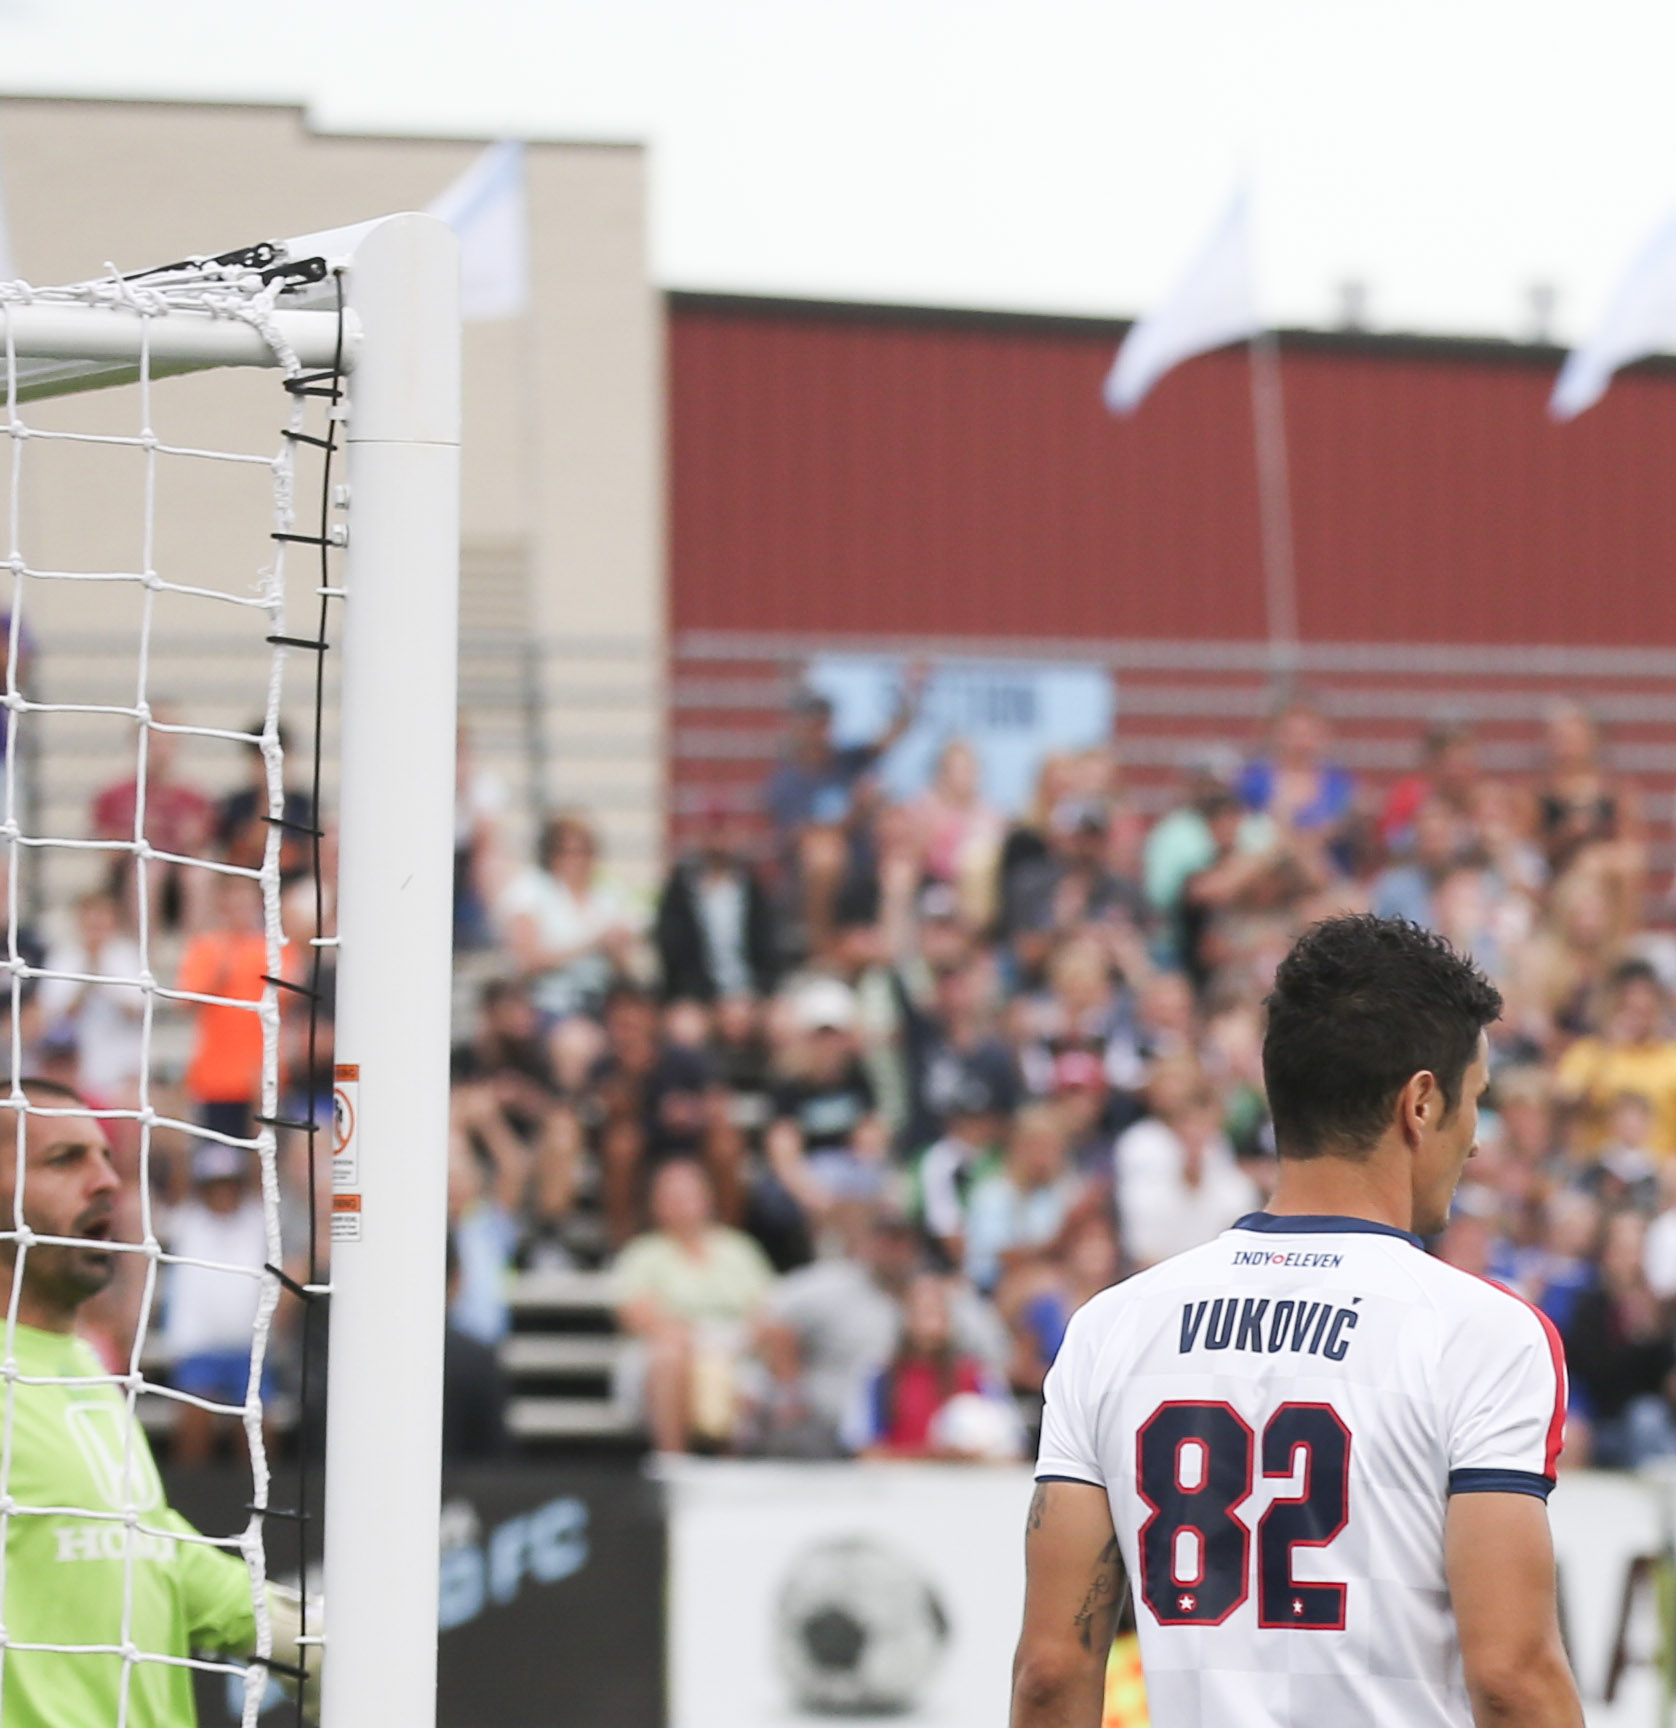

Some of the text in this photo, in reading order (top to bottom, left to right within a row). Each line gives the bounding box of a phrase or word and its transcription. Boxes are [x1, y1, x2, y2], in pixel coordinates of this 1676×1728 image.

[1284, 1253, 1343, 1268] ELEVEN
[1178, 1297, 1363, 1361] VUKOVIĆ
[1136, 1400, 1352, 1631] 82
